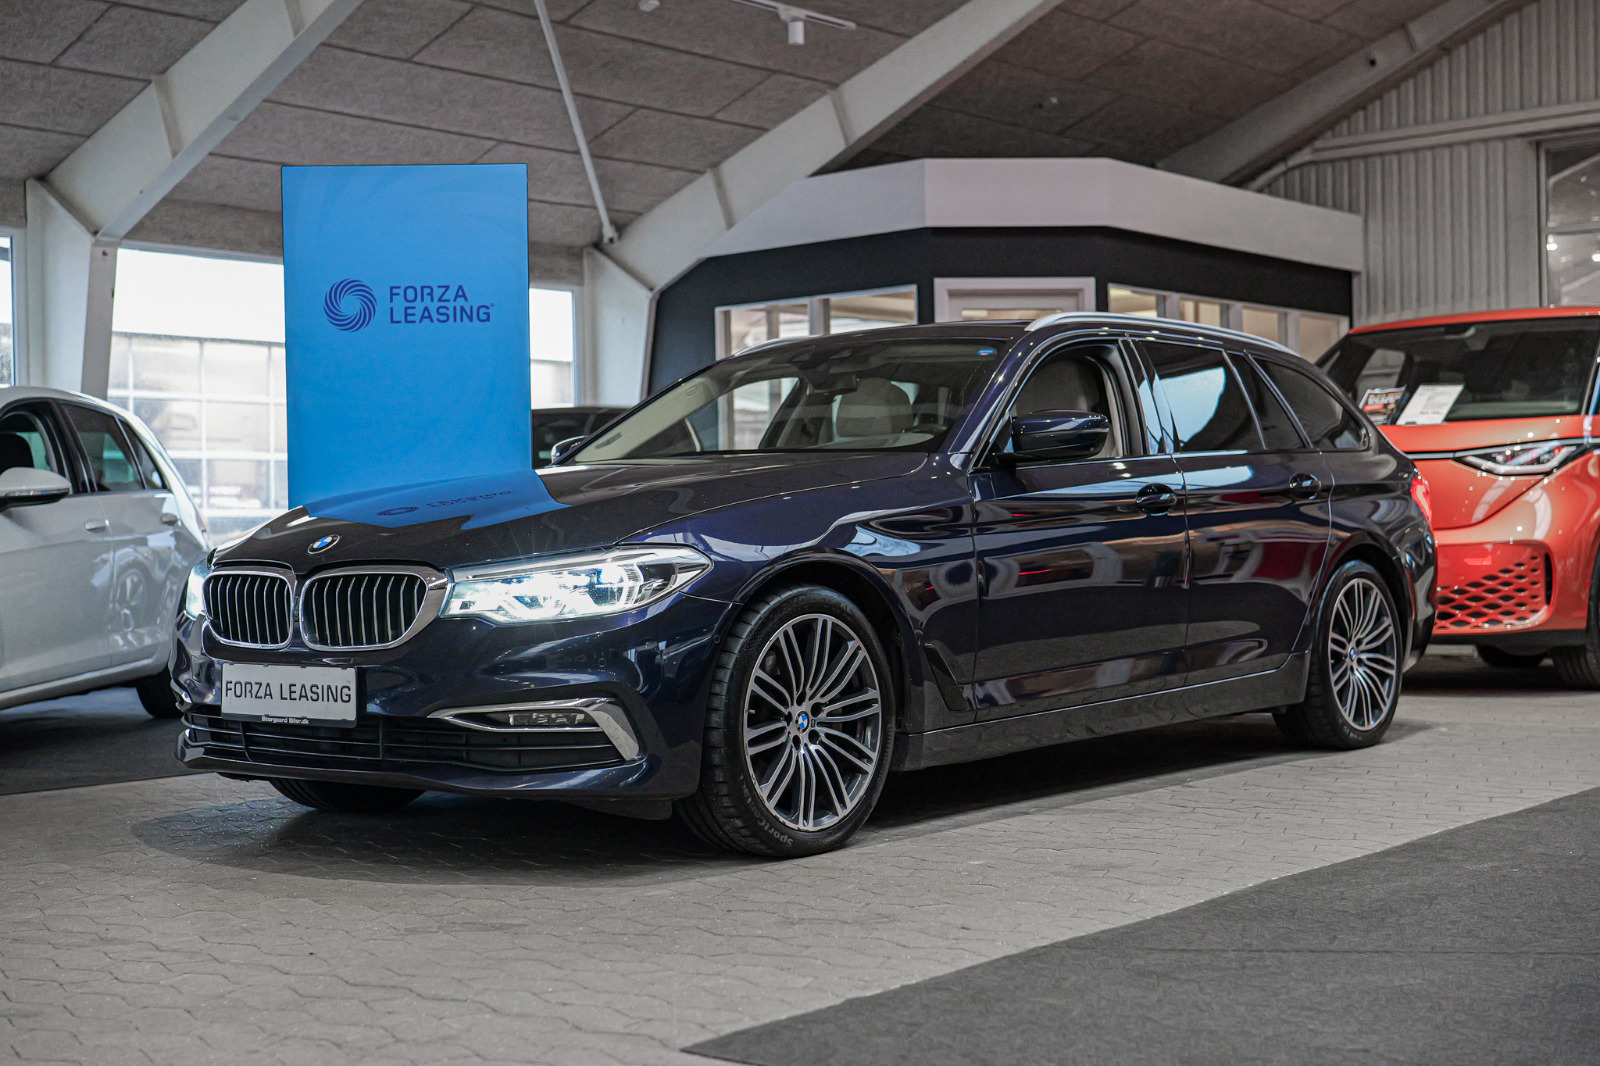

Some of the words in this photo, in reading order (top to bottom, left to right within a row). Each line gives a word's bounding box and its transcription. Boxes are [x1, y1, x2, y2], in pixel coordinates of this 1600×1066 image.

[389, 285, 468, 303] FORZA
[225, 680, 273, 700] FORZA
[280, 683, 351, 704] LEASING
